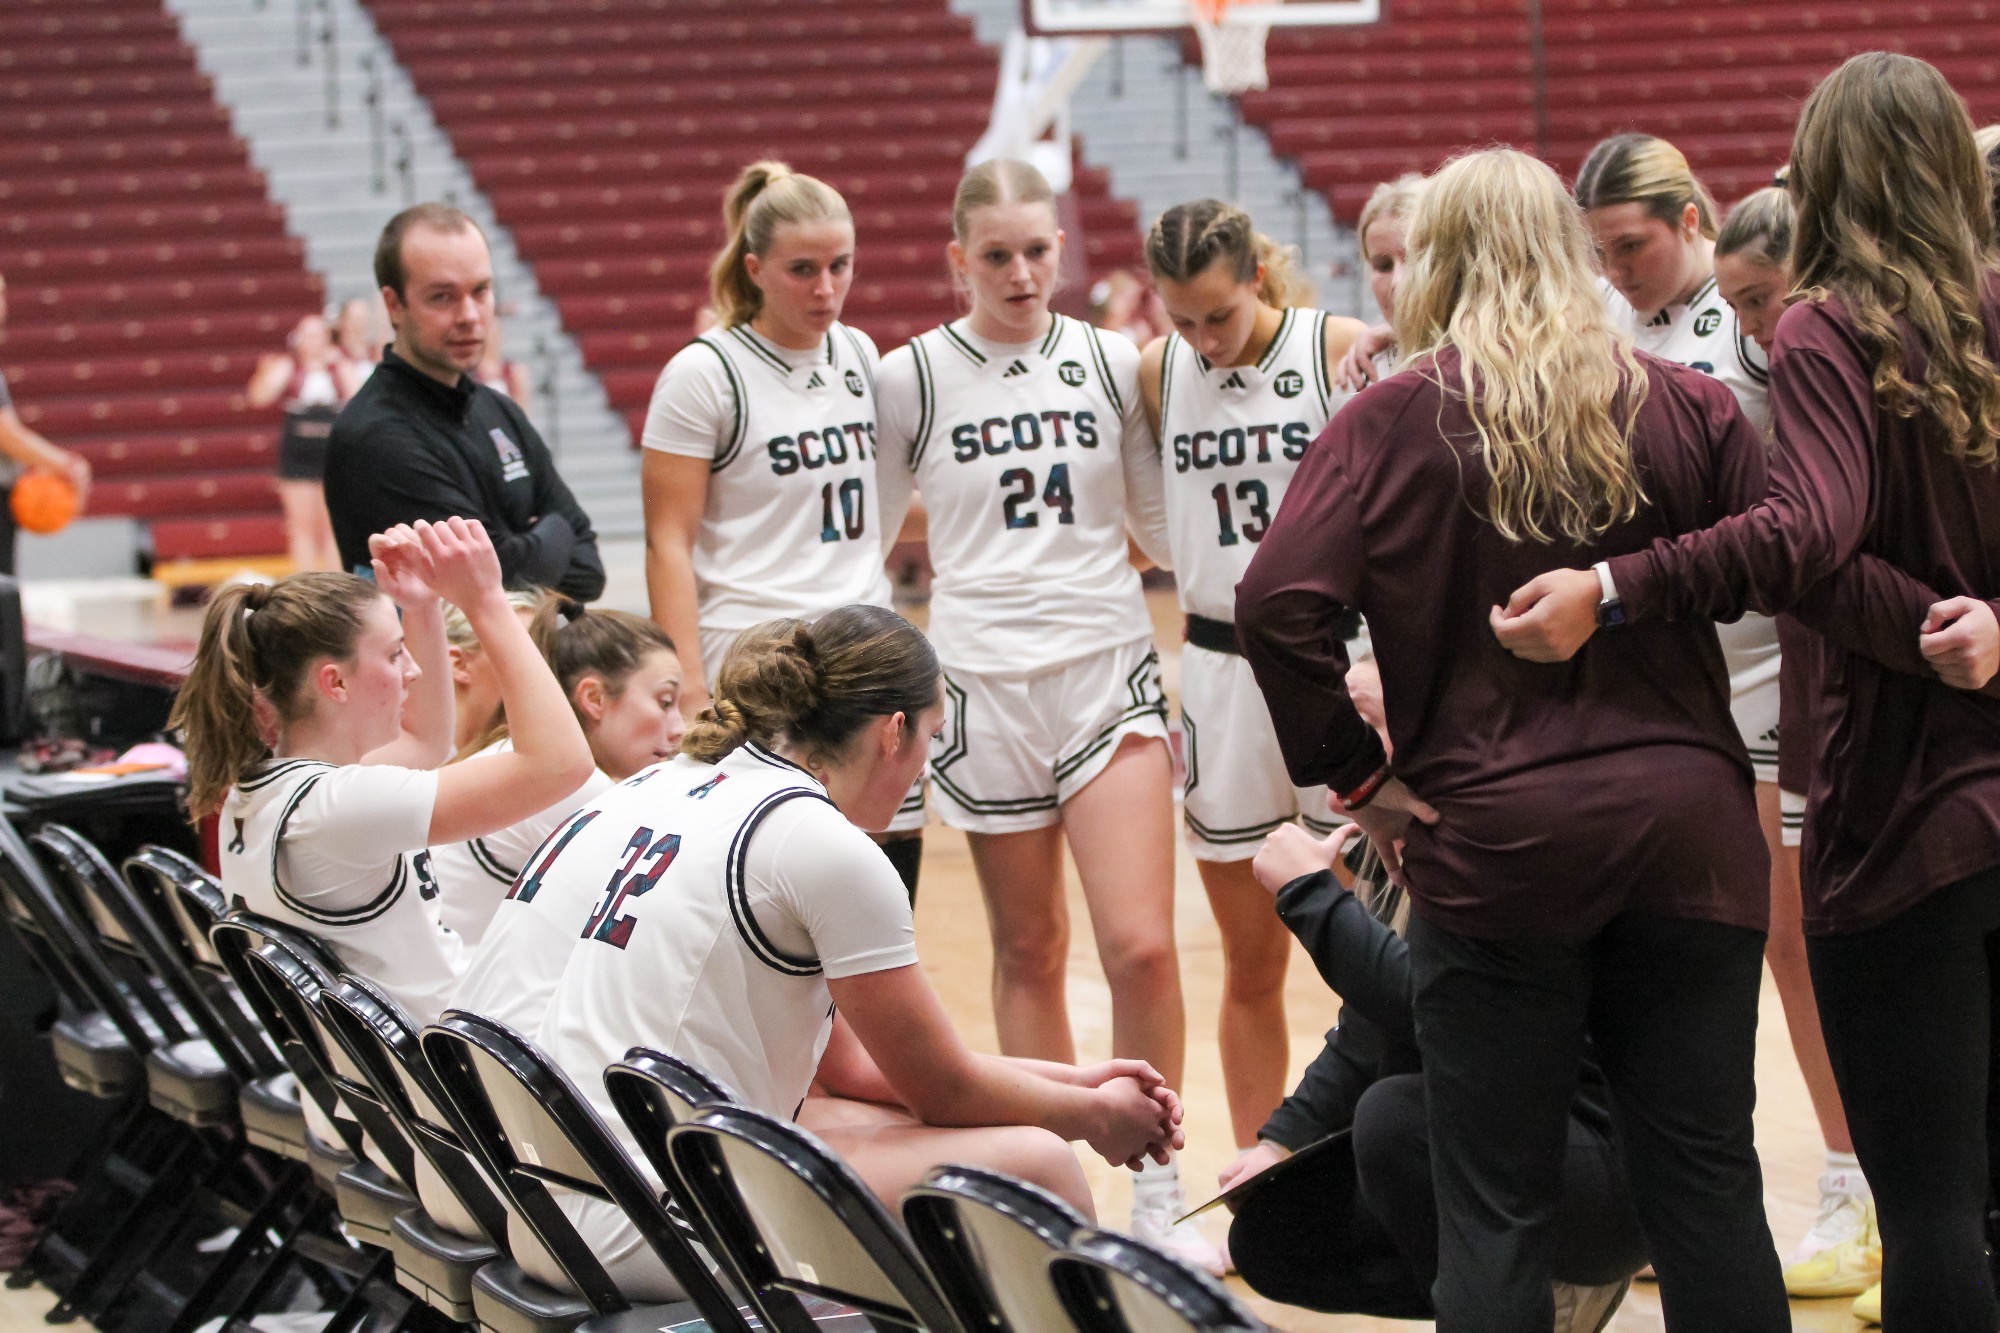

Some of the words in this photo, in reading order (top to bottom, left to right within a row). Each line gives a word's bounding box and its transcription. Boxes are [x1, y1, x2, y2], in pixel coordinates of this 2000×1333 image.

[1697, 313, 1721, 332] TE
[1060, 366, 1085, 382] TE
[1276, 375, 1301, 393] TE
[952, 410, 1099, 464] SCOTS
[1174, 422, 1310, 474] SCOTS
[821, 478, 864, 543] 10
[1000, 463, 1074, 530] 24
[1212, 479, 1271, 547] 13
[686, 772, 729, 800] A
[505, 808, 602, 904] 11
[580, 826, 682, 950] 32
